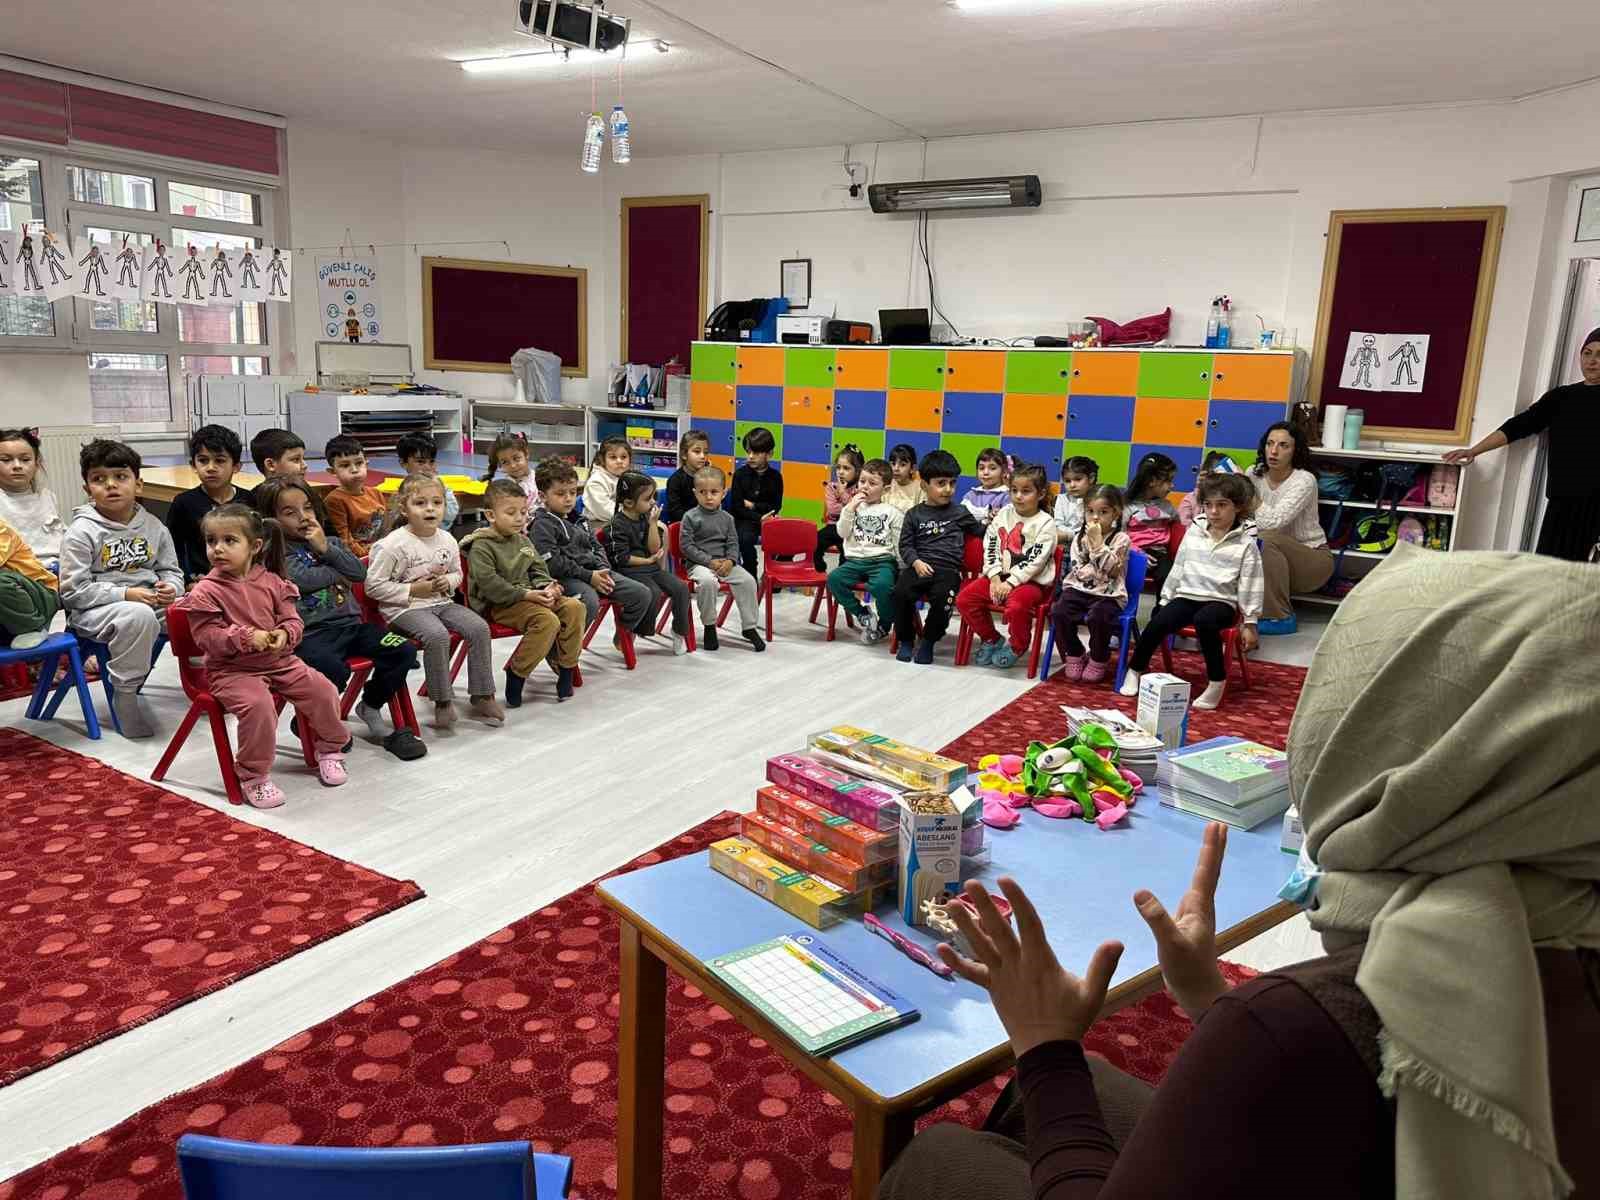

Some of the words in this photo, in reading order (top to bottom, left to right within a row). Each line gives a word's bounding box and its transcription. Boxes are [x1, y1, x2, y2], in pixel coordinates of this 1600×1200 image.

[328, 278, 356, 288] MUTLU
[359, 278, 370, 288] OL
[106, 539, 148, 556] TAKE
